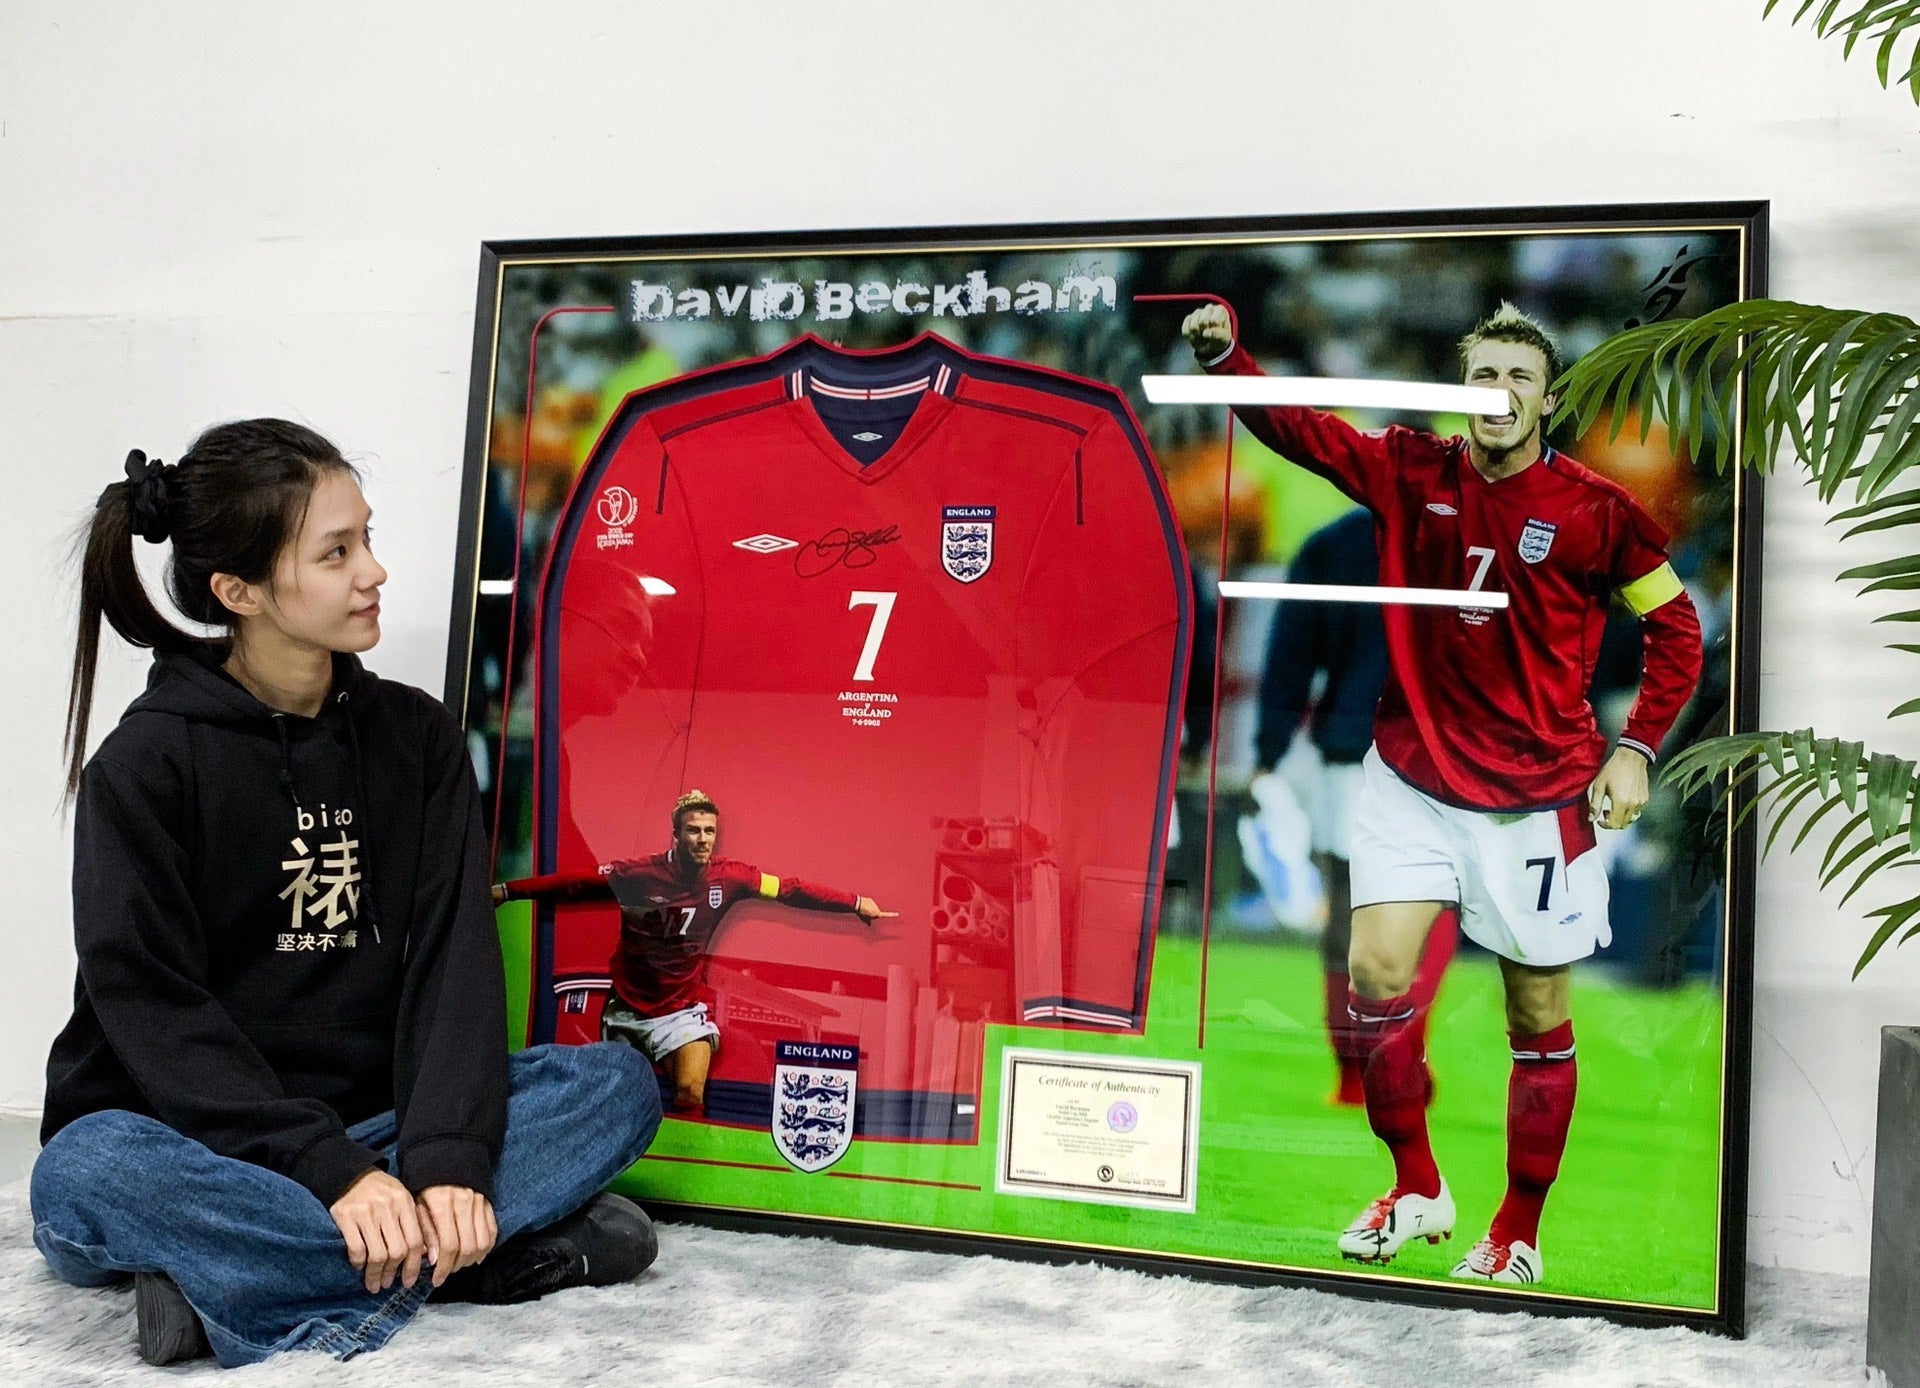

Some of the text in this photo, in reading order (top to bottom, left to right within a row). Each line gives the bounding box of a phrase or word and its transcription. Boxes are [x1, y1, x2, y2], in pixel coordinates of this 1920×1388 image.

[946, 508, 992, 517] ENGLAND
[1466, 546, 1496, 592] 7
[848, 590, 898, 682] 7
[838, 691, 899, 702] ARGENTINA
[842, 707, 892, 718] ENGLAND
[278, 830, 362, 930] 裱
[1525, 856, 1556, 911] 7
[678, 907, 696, 935] 7
[783, 1045, 853, 1060] ENGLAND
[1038, 1075, 1161, 1097] Certificate of Authenticity
[1415, 1214, 1424, 1228] 7
